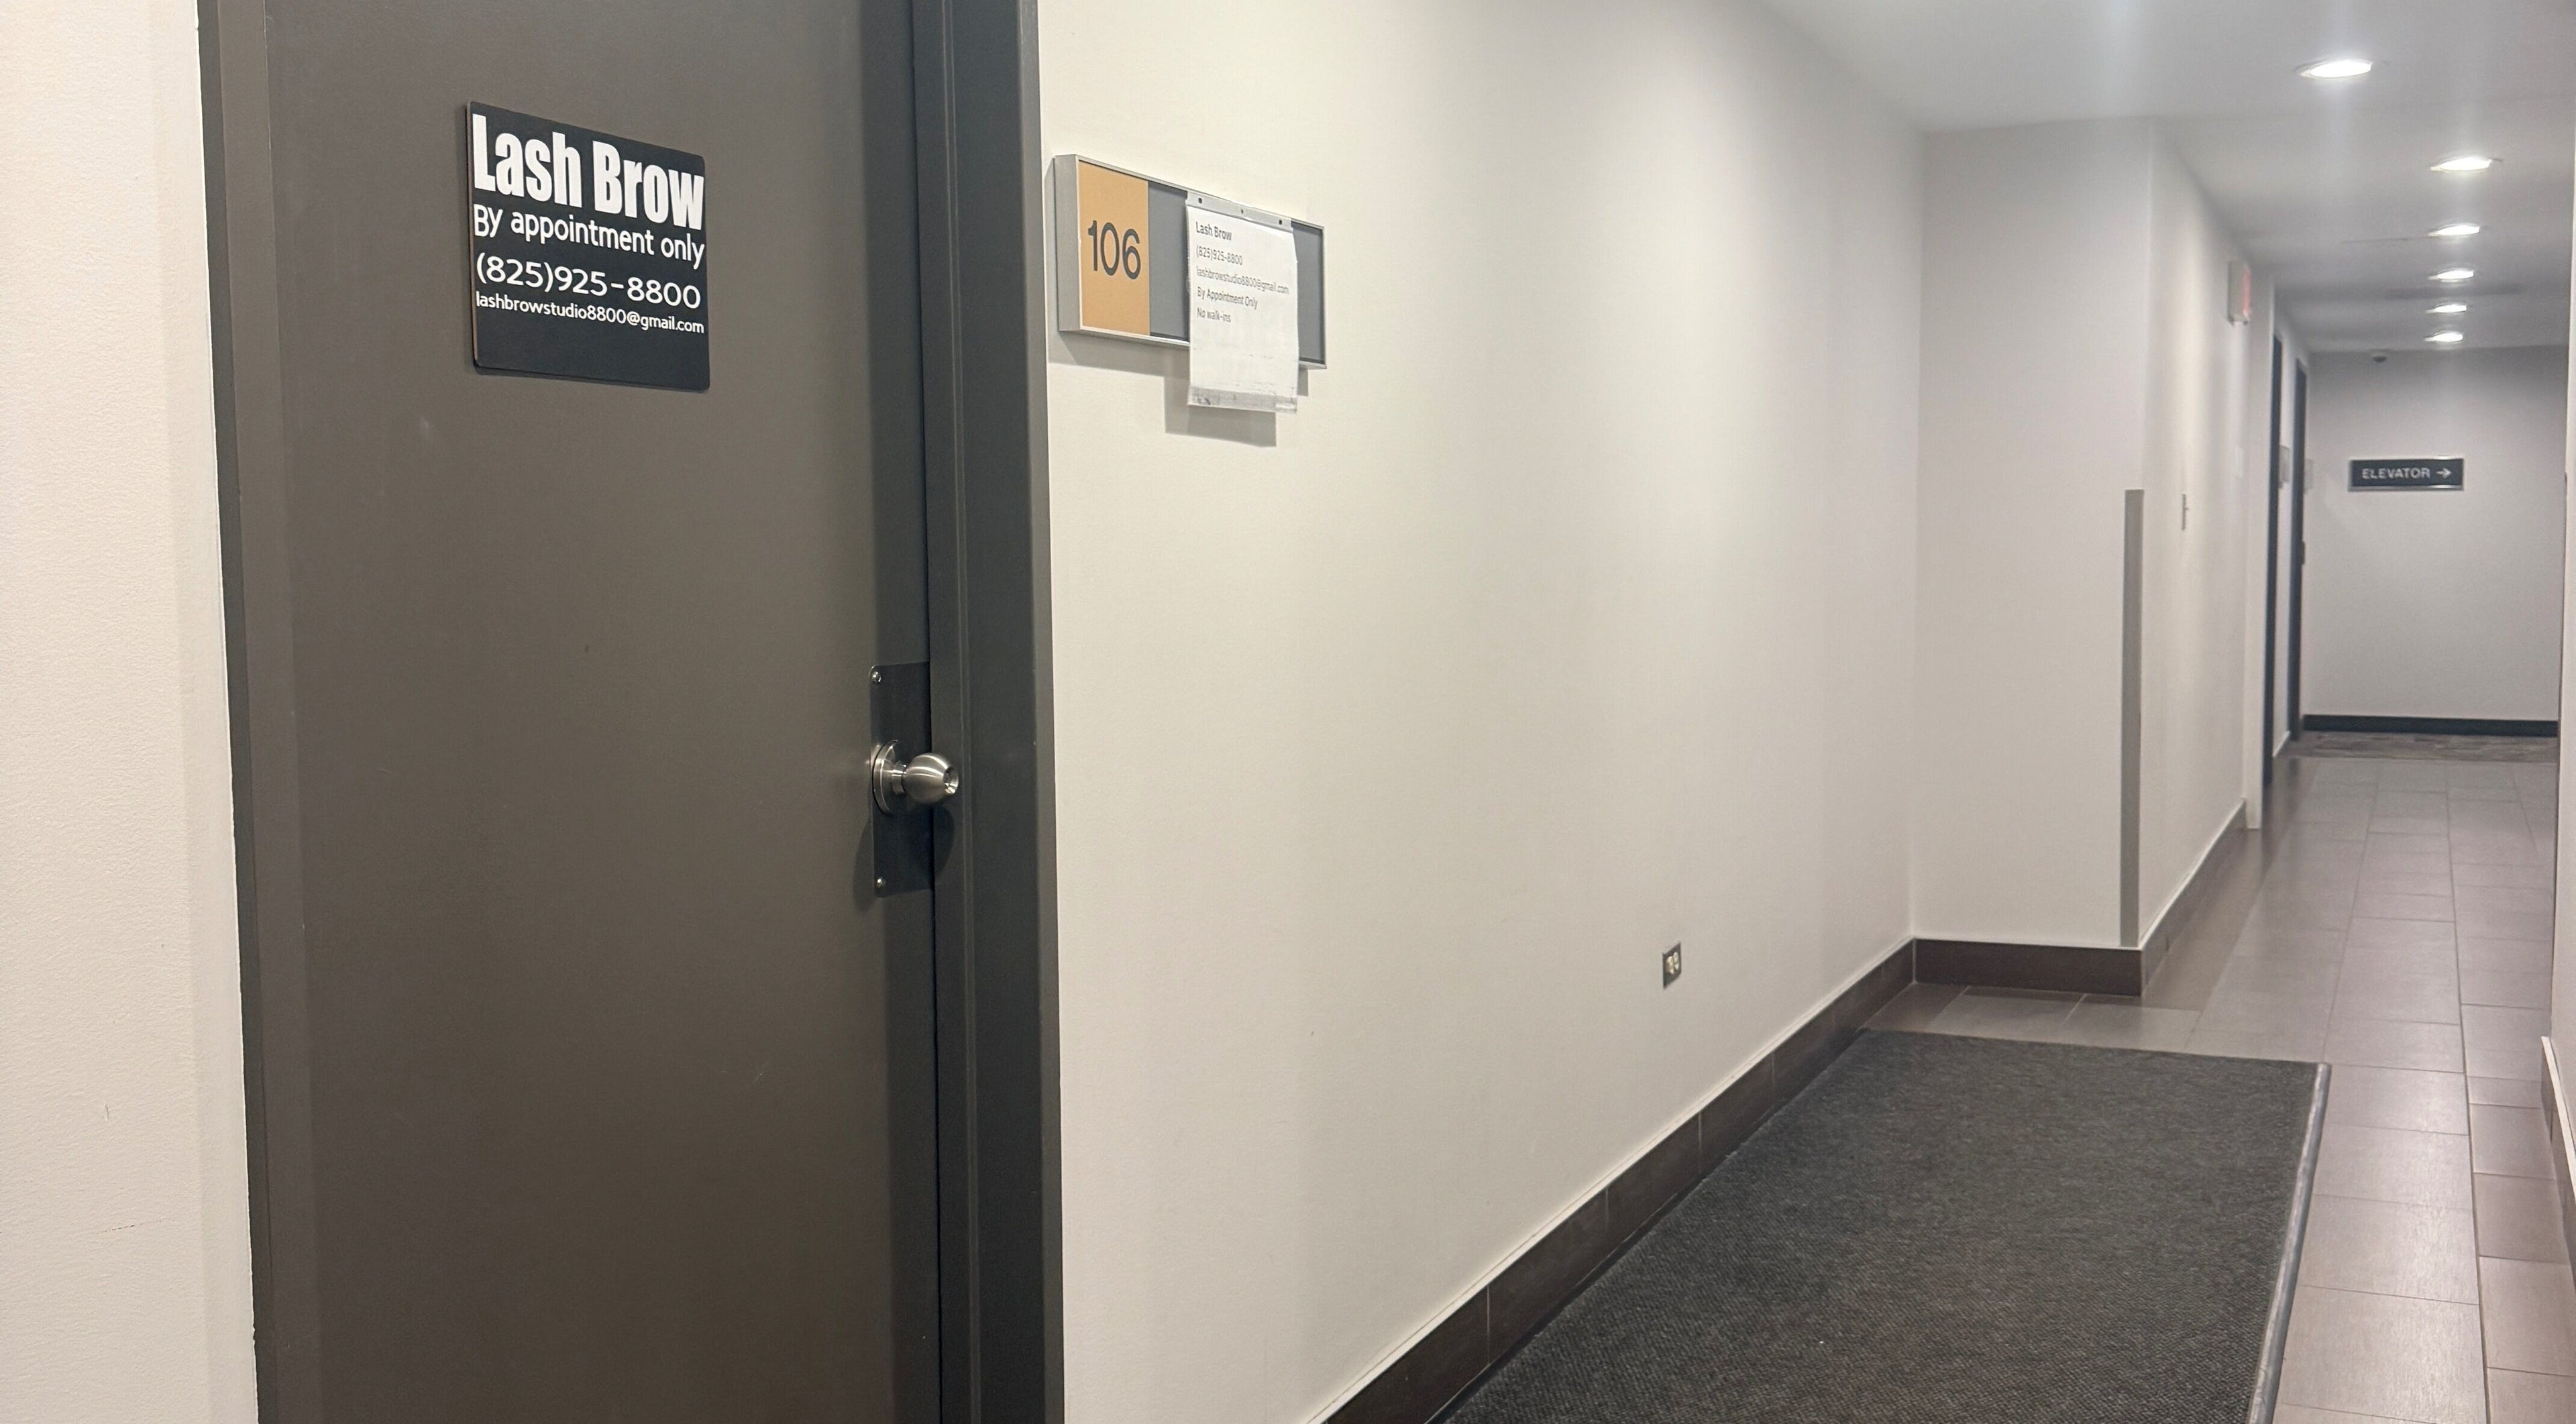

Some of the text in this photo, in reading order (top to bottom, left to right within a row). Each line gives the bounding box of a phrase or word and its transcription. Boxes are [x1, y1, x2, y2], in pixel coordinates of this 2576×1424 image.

[472, 113, 704, 230] Lash Brow
[473, 204, 704, 270] By appointment only
[1195, 221, 1232, 240] Lash Brow
[1087, 220, 1141, 280] 106
[1196, 245, 1243, 265] (825)925-8800
[476, 252, 700, 309] (825)925-8800
[1196, 266, 1289, 294] lashbrowstudio8800@gmail.com
[1197, 286, 1258, 309] By Appointment Only
[476, 291, 704, 333] lashbrowstudio8800@gmail.com
[1197, 307, 1206, 318] No
[2361, 467, 2430, 480] ELEVATOR
